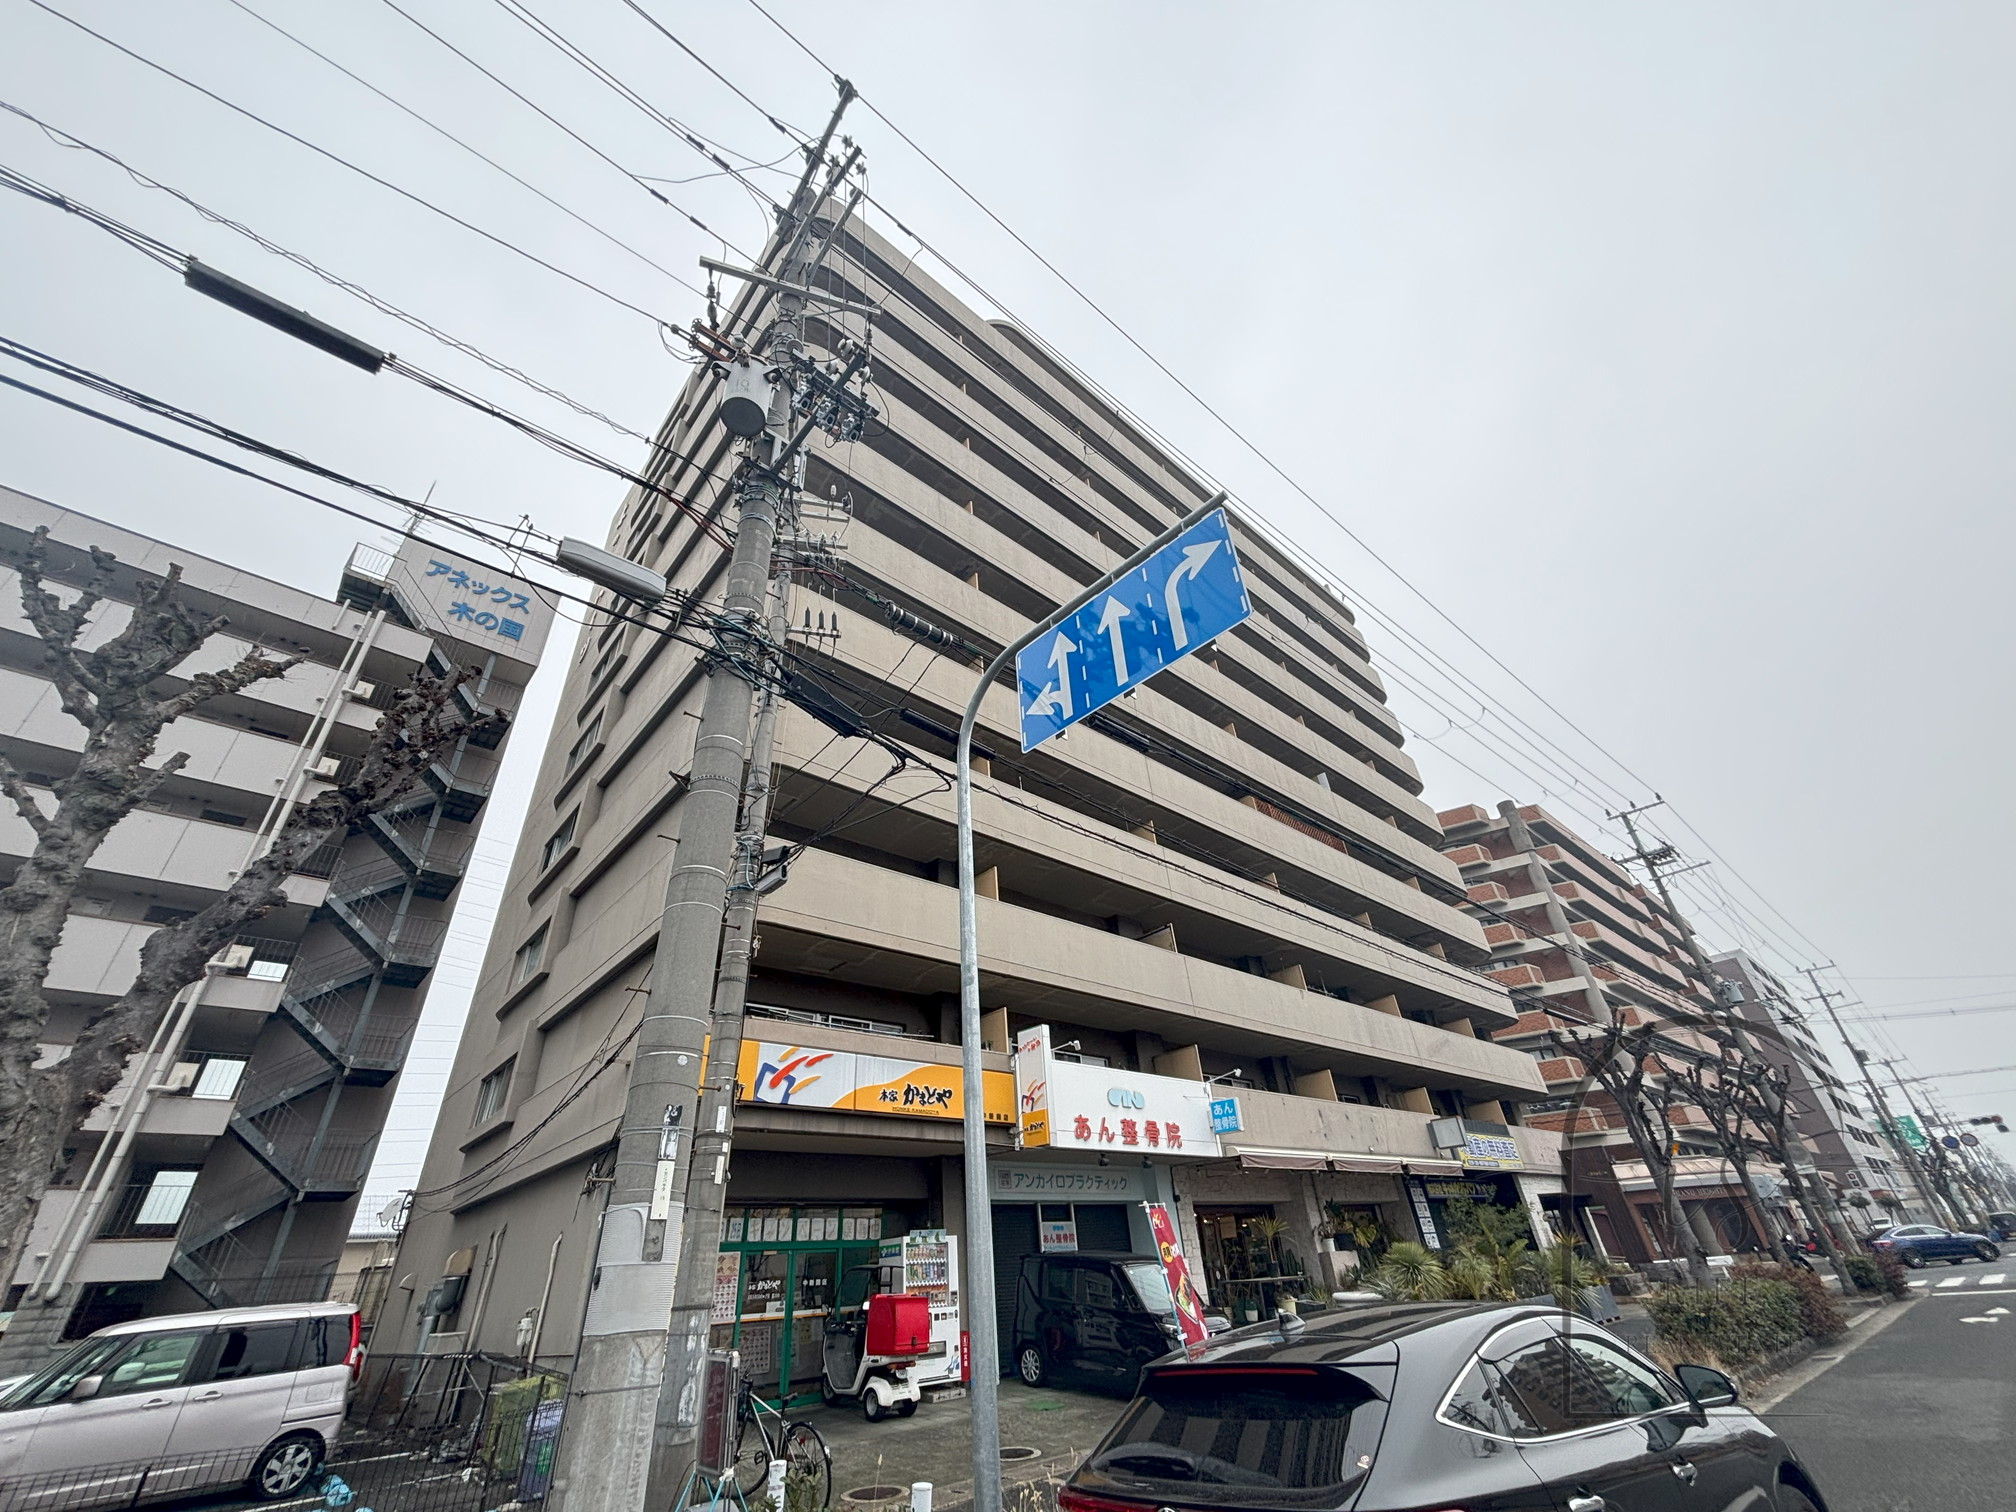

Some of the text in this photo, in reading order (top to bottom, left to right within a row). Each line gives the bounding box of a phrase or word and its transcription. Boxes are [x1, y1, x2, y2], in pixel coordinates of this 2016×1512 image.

[425, 559, 531, 614] アネックス
[448, 601, 525, 641] 木の国
[879, 1089, 898, 1103] 本家
[1213, 1102, 1233, 1115] あん
[1073, 1113, 1183, 1148] あん整骨院
[1214, 1116, 1238, 1131] 整骨院
[1043, 1234, 1075, 1243] あん整骨院
